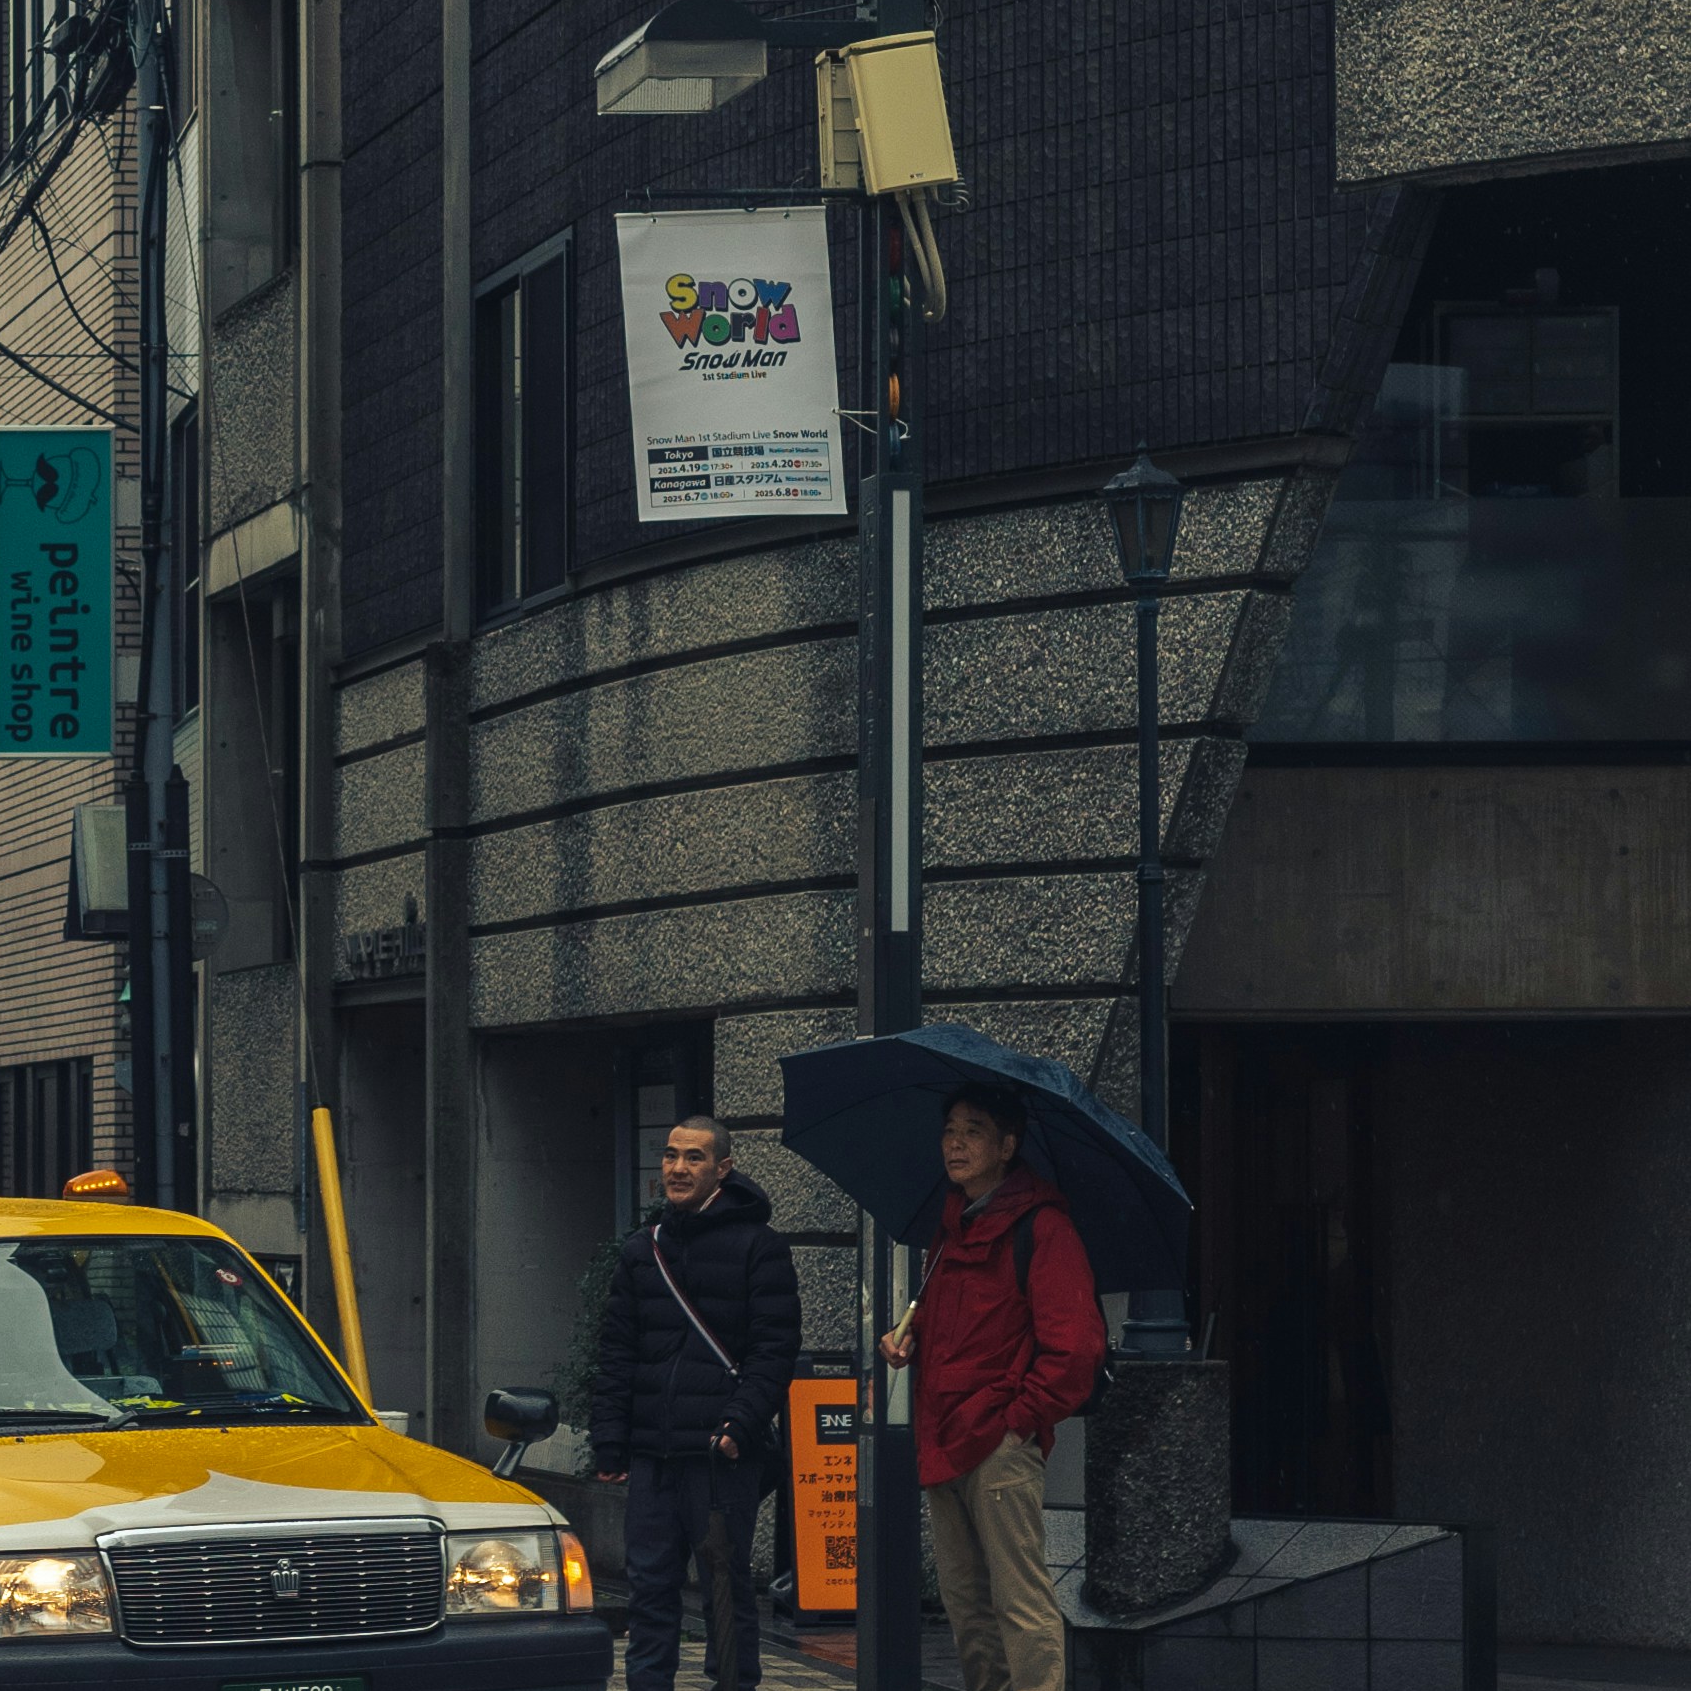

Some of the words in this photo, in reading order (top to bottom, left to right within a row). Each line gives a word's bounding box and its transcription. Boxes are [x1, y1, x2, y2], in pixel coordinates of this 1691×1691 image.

[665, 273, 792, 313] Snow
[659, 304, 801, 349] World
[678, 350, 741, 371] Snow
[741, 349, 788, 368] Man
[702, 372, 715, 381] 1st
[716, 371, 750, 380] Stadium
[751, 370, 767, 379] Live
[647, 436, 672, 445] Snow
[675, 434, 695, 443] Man
[699, 433, 710, 442] 1st
[713, 431, 750, 441] Stadium
[753, 430, 771, 440] Live
[773, 429, 798, 439] Snow
[800, 429, 828, 438] World
[664, 451, 694, 460] Tokyo
[712, 446, 764, 458] 国立競技場
[654, 479, 706, 490] Kanagawa
[714, 474, 783, 486] 日産スタジアム
[11, 571, 41, 652] wine
[40, 543, 91, 740] peintre
[5, 663, 41, 743] shop
[824, 1455, 852, 1466] エンネ
